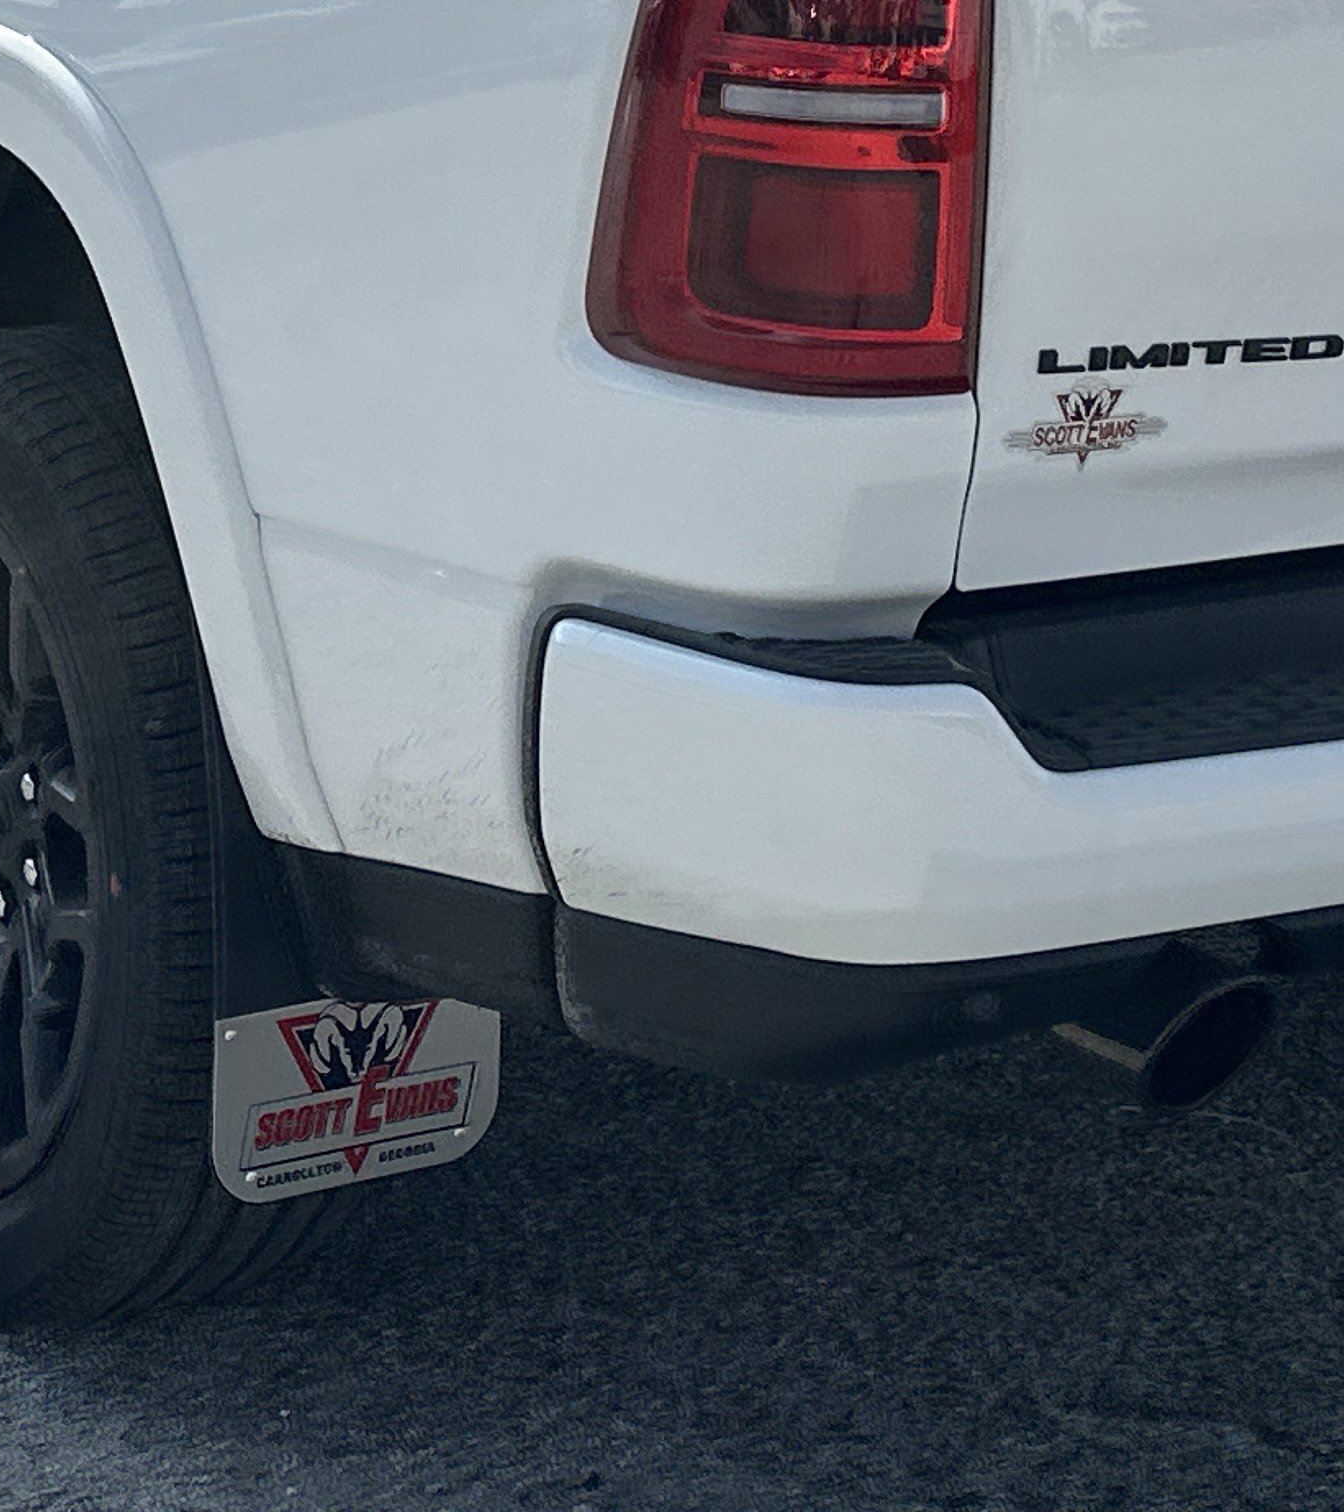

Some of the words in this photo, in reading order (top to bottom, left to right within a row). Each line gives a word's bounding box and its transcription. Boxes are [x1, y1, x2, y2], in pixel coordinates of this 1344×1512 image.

[1037, 334, 1344, 374] LIMITED
[1033, 425, 1085, 447] SCOTT
[1085, 419, 1138, 445] EVANS
[256, 1098, 353, 1151] SCOTT
